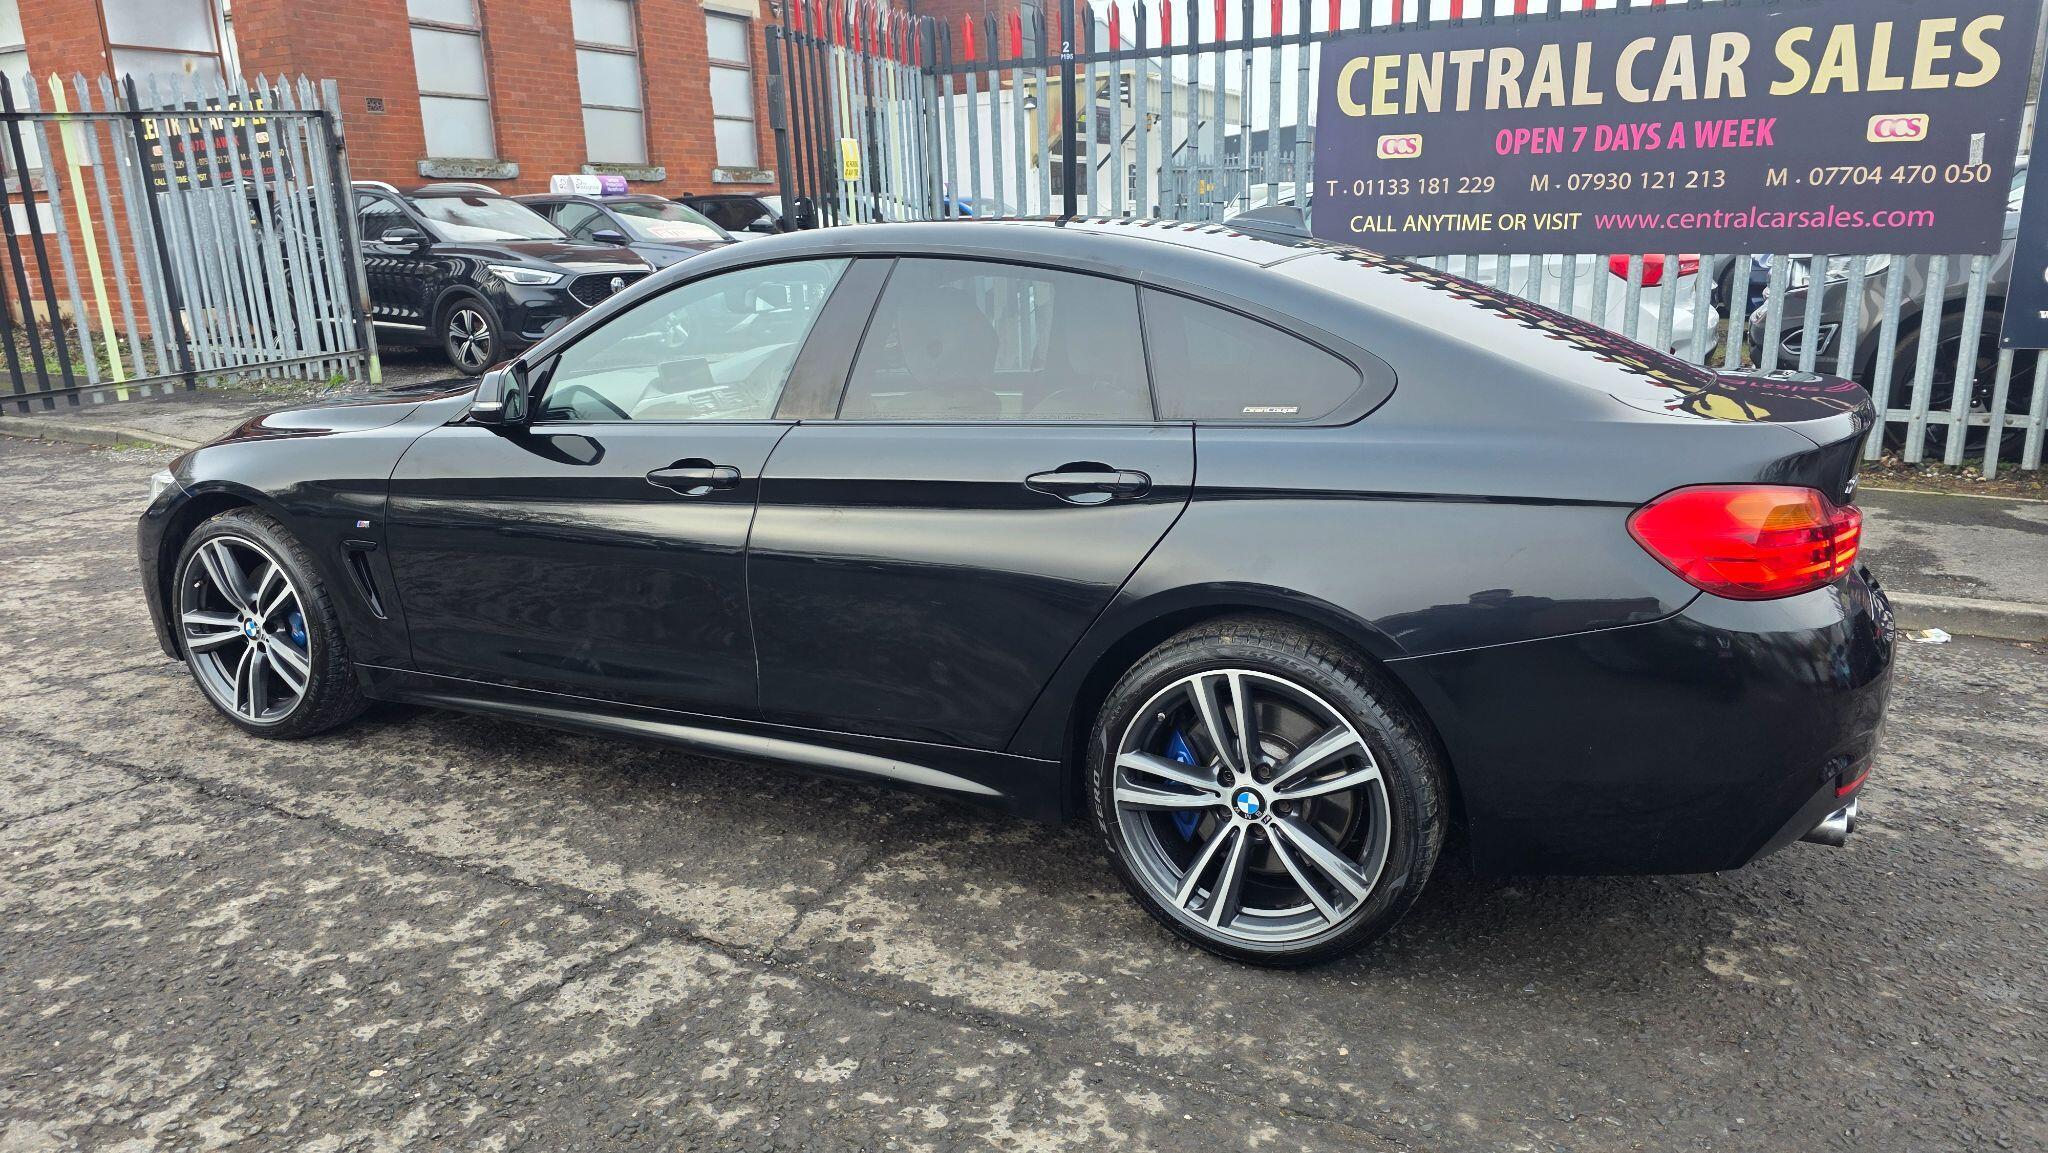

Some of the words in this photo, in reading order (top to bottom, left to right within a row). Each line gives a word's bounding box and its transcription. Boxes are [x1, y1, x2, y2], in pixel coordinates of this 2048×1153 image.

[1062, 41, 1070, 53] 2
[1336, 41, 1604, 117] CENTRAL
[1615, 31, 1751, 104] CAR
[1768, 14, 2005, 96] SALES
[1495, 126, 1565, 156] OPEN
[1571, 126, 1588, 153] 7
[1594, 122, 1662, 152] DAYS
[1666, 121, 1686, 150] A
[1694, 117, 1777, 149] WEEK
[1873, 117, 1922, 138] CCS
[1567, 171, 1632, 191] 07930
[1640, 171, 1676, 190] 121
[1684, 169, 1726, 189] 213
[1808, 165, 1883, 186] 07704
[1889, 164, 1937, 184] 470
[1944, 163, 1992, 184] 050
[1353, 178, 1410, 197] 01133
[1418, 177, 1450, 195] 181
[1456, 176, 1496, 194] 229
[1350, 214, 1397, 233] CALL
[1403, 213, 1493, 232] ANYTIME
[1498, 213, 1527, 231] OR
[1533, 212, 1583, 231] VISIT
[1594, 204, 1936, 230] www.centralcarsales.com
